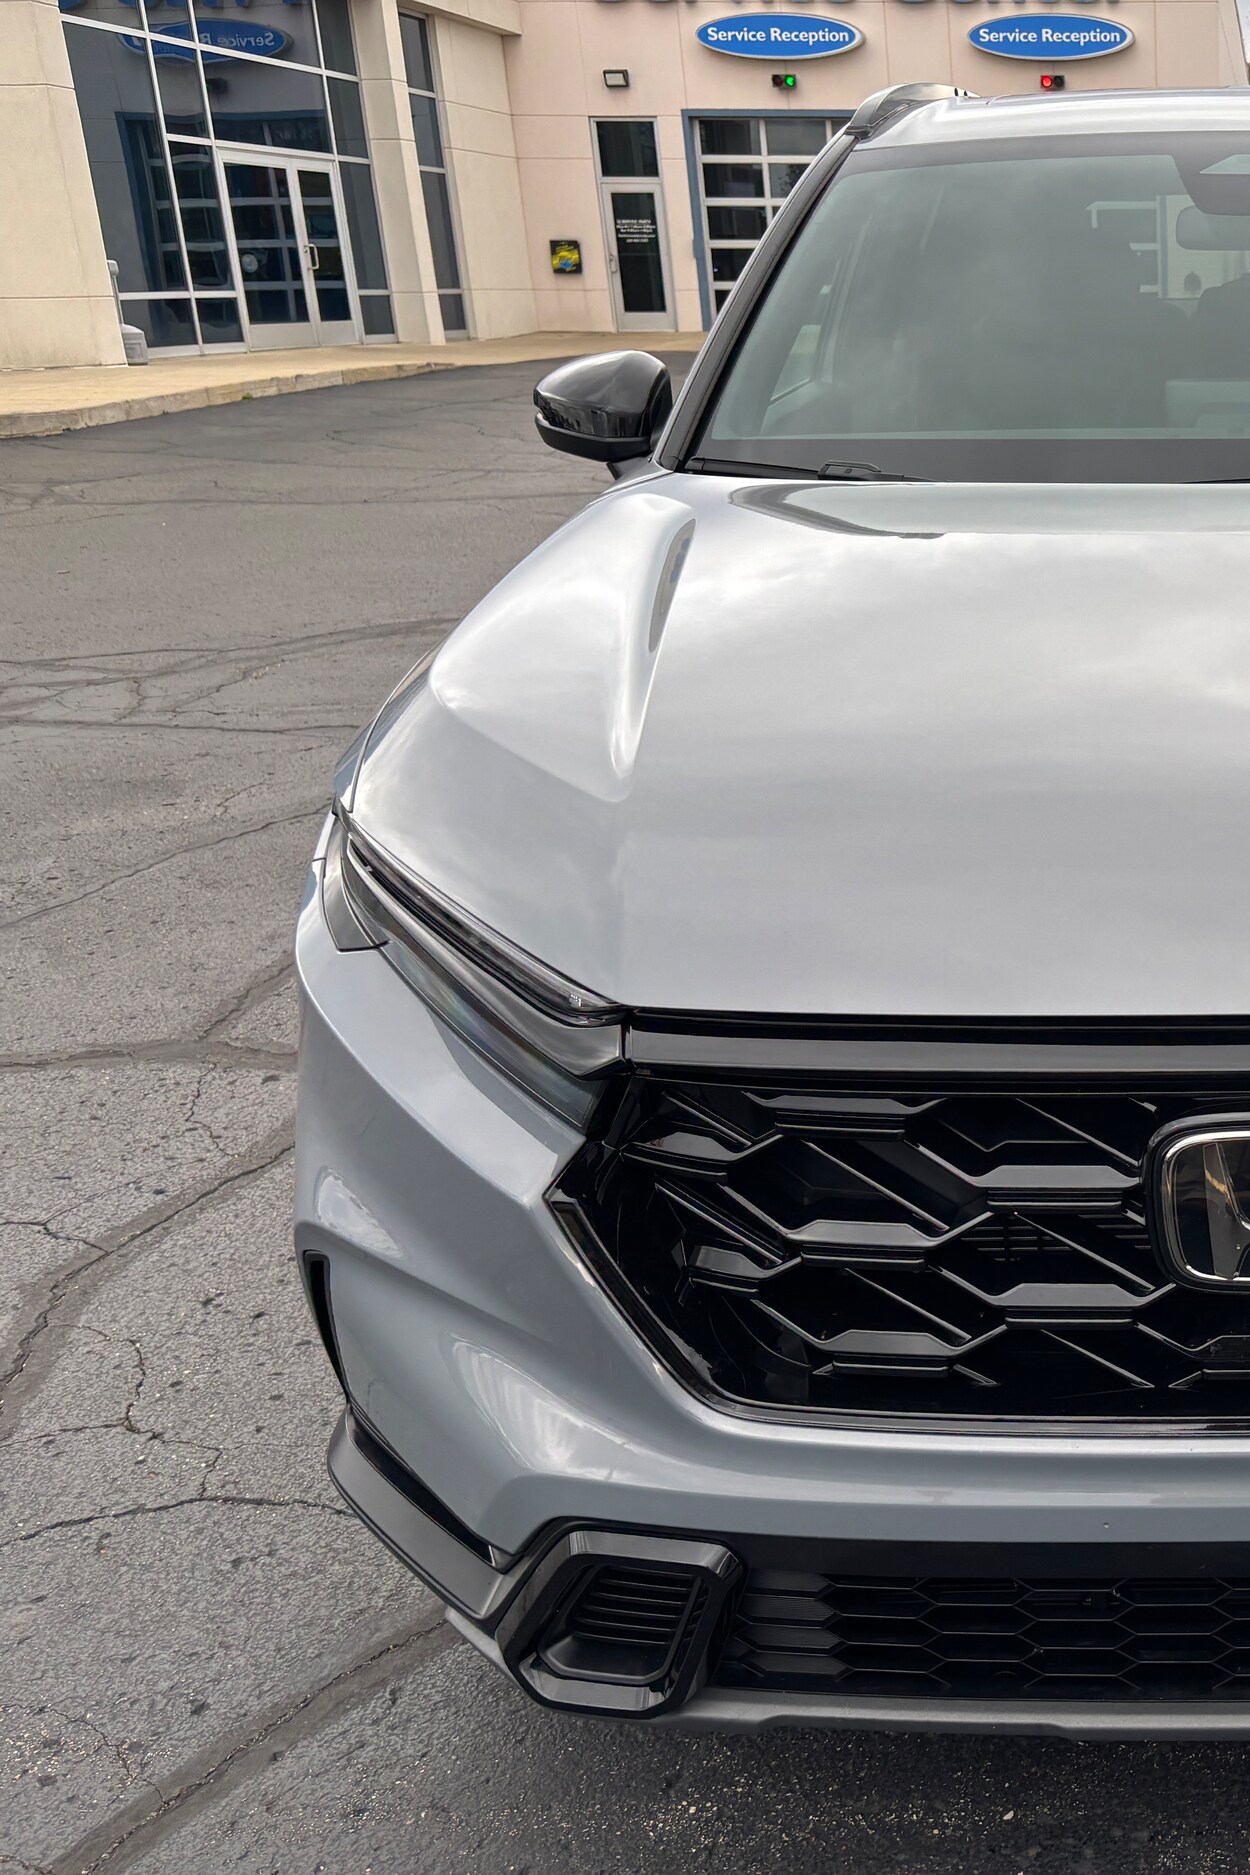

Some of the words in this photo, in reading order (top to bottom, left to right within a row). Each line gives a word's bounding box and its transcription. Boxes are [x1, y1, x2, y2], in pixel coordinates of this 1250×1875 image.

[707, 27, 766, 41] Service
[770, 28, 849, 45] Reception
[979, 28, 1037, 42] Service
[1041, 29, 1120, 46] Reception
